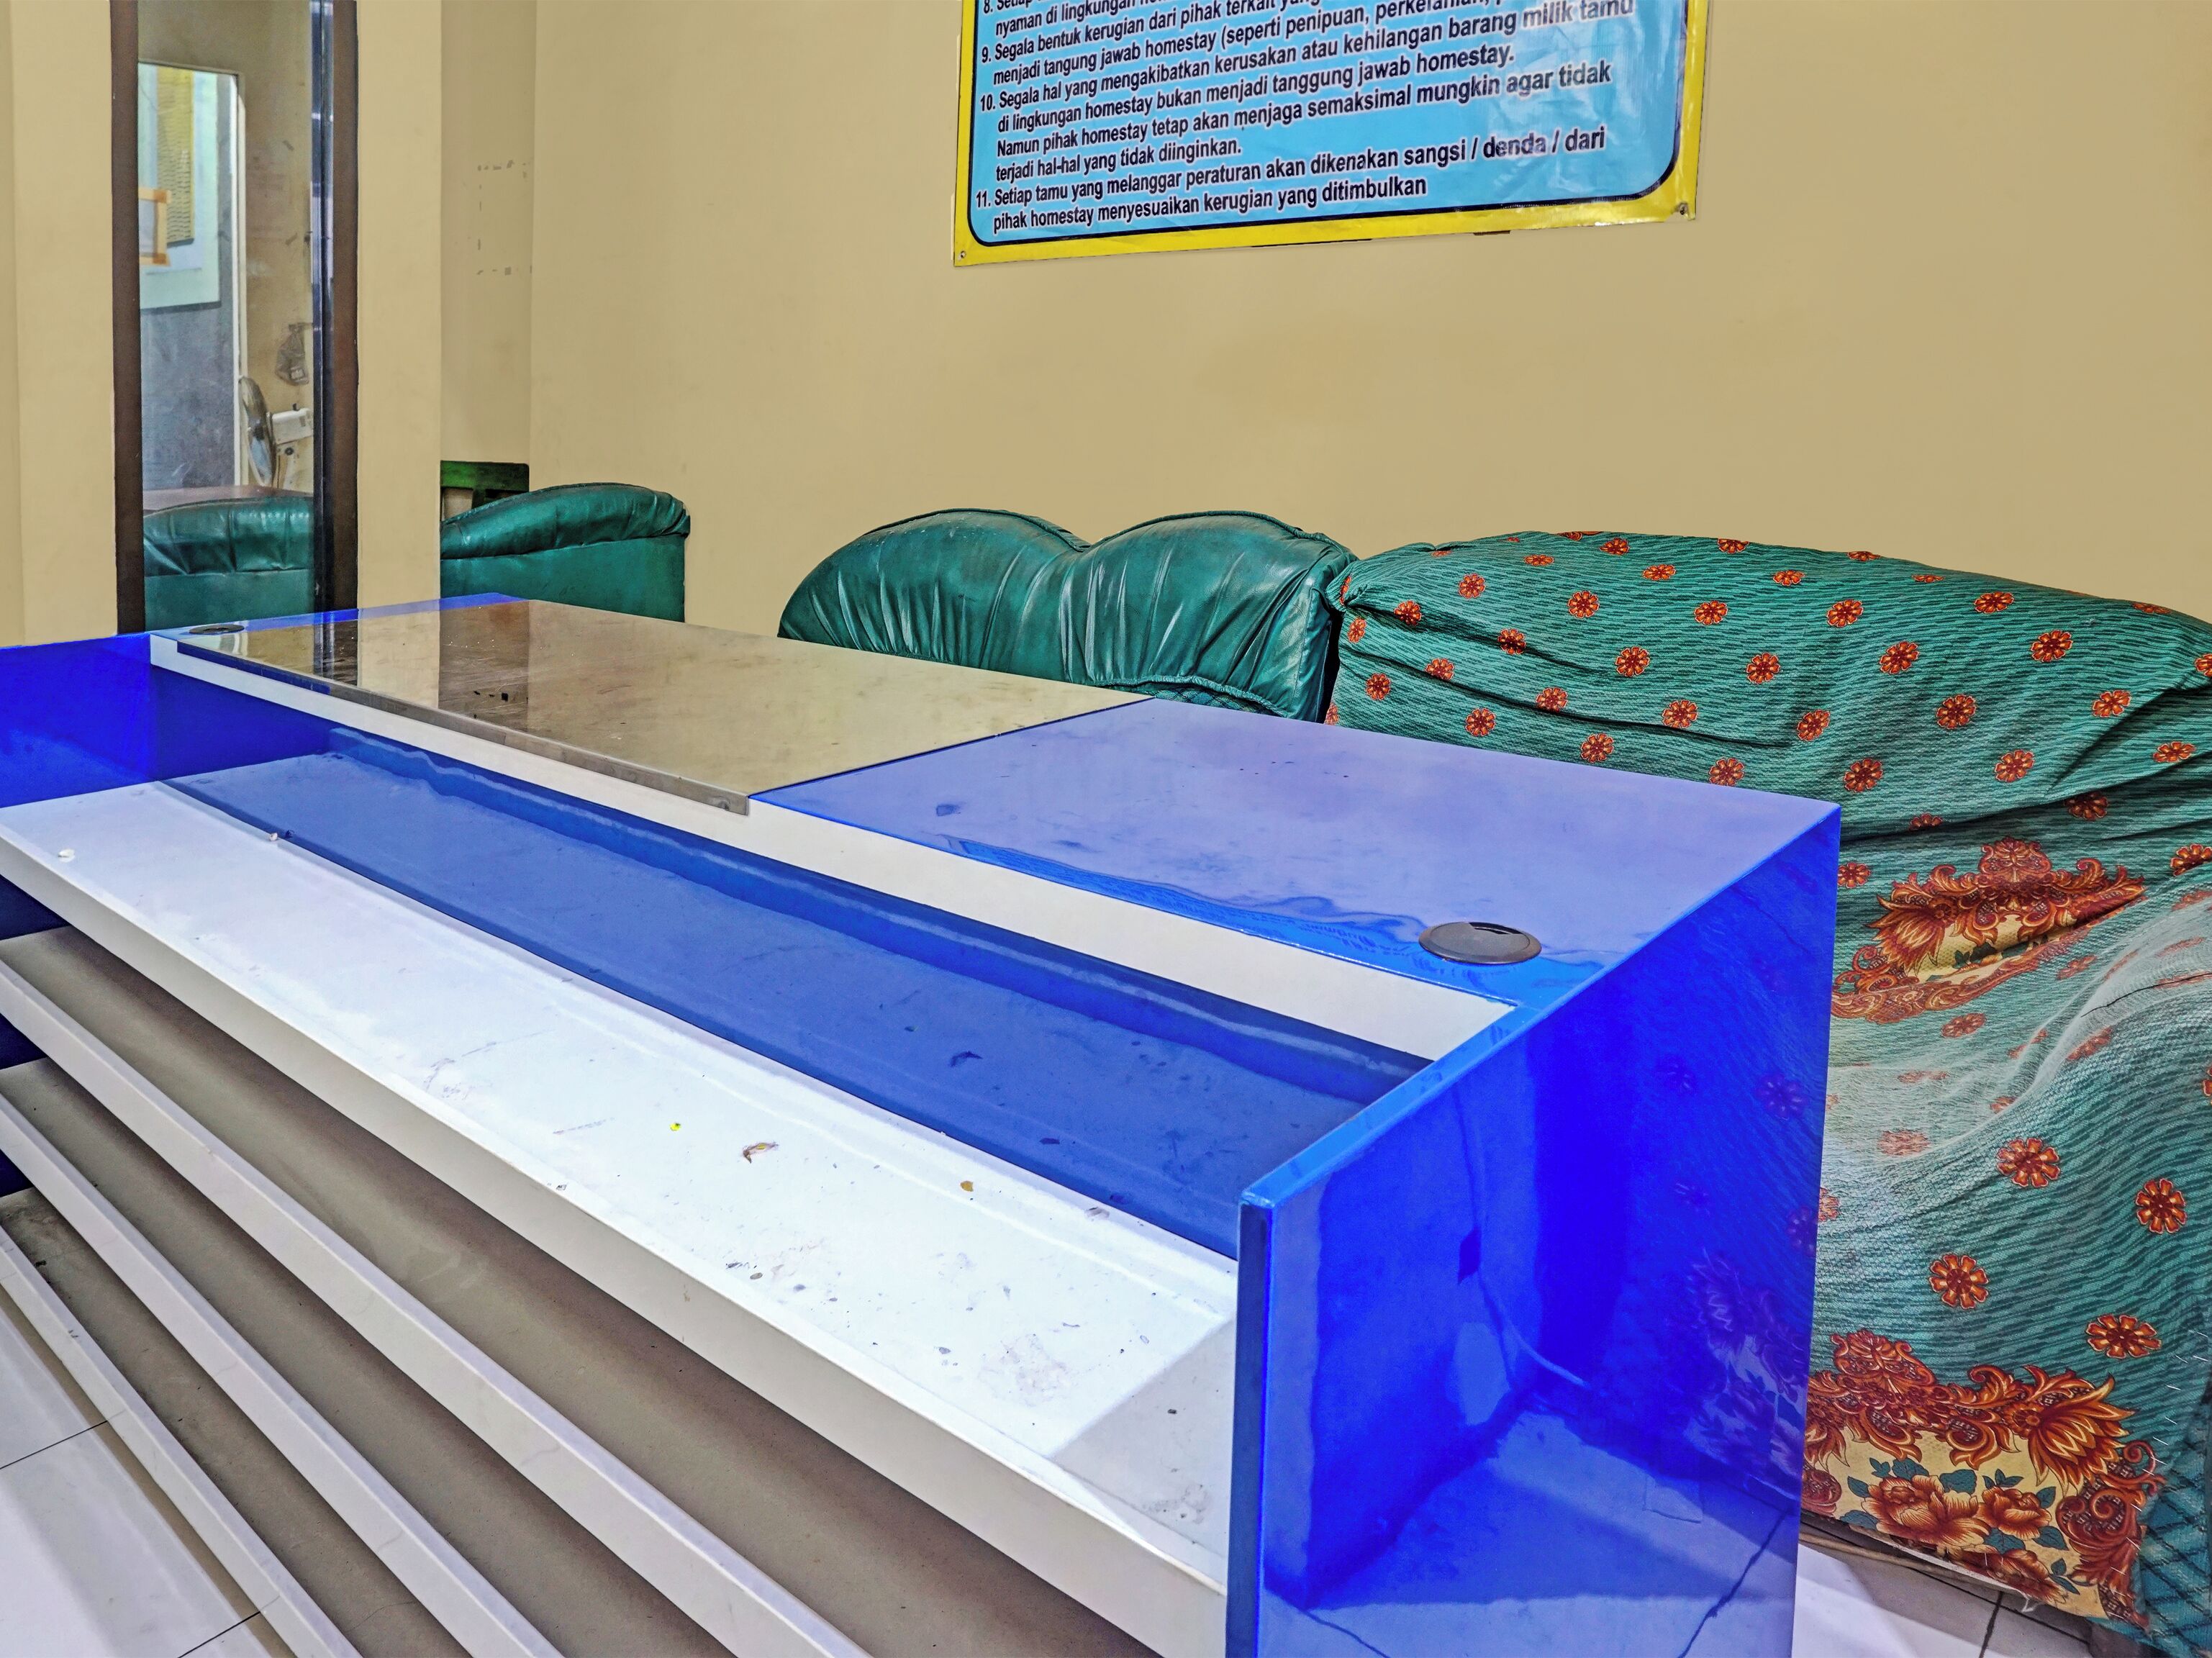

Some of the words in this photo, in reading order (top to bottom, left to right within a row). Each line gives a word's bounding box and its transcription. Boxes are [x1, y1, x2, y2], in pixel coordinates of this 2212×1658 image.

[982, 46, 992, 63] 9.
[994, 37, 1035, 62] Segala
[1037, 27, 1082, 52] bentuk
[1084, 17, 1144, 42] kerugian
[1148, 7, 1177, 30] dari
[1180, 0, 1221, 30] pihak
[983, 0, 993, 14] 8.
[993, 59, 1041, 86] menjadi
[1043, 53, 1097, 77] tangung
[1099, 42, 1141, 71] jawab
[1145, 32, 1217, 58] homestay
[1221, 16, 1281, 50] (seperti
[1285, 6, 1369, 40] penipuan,
[1375, 0, 1490, 25] perkela,
[995, 13, 1042, 39] nyaman
[1046, 5, 1058, 24] di
[1061, 0, 1136, 23] lingkungan
[980, 94, 996, 112] 10.
[999, 86, 1040, 110] Segala
[1043, 81, 1062, 101] hal
[1064, 79, 1098, 102] yang
[1100, 60, 1210, 91] mengakibatkan
[1215, 46, 1297, 73] kerusakan
[1301, 40, 1338, 60] atau
[1343, 24, 1443, 54] kehilangan
[1449, 13, 1517, 38] barang
[1522, 0, 1574, 28] milik
[1579, 0, 1633, 20] tamu
[997, 114, 1010, 133] di
[1012, 107, 1082, 133] lingkungan
[1085, 96, 1153, 119] homestay
[1156, 88, 1202, 109] bukan
[1206, 75, 1268, 104] menjadi
[1272, 68, 1353, 94] tanggung
[1357, 55, 1411, 87] jawab
[1416, 44, 1514, 73] homestay.
[997, 139, 1040, 158] Namun
[1043, 130, 1079, 155] pihak
[1082, 122, 1148, 146] homestay
[1151, 117, 1189, 137] tetap
[1192, 111, 1229, 132] akan
[1233, 102, 1302, 127] menjaga
[1307, 83, 1411, 117] semaksimal
[1416, 74, 1500, 104] mungkin
[1505, 71, 1554, 96] agar
[1559, 60, 1611, 87] tidak
[976, 190, 991, 208] 11.
[994, 186, 1033, 207] Setiap
[1035, 185, 1068, 201] tamu
[1071, 181, 1104, 203] yang
[1107, 173, 1182, 194] melanggar
[1186, 165, 1261, 191] peraturan
[1266, 158, 1305, 179] akan
[1310, 148, 1398, 175] dikenakan
[1404, 138, 1466, 168] sangsi
[1471, 137, 1479, 160] /
[1482, 132, 1546, 158] denda
[1551, 130, 1559, 153] /
[1564, 125, 1605, 152] dari
[996, 160, 1034, 184] terjadi
[1037, 154, 1081, 176] hal-hal
[1083, 154, 1117, 176] yang
[1120, 145, 1155, 167] tidak
[1159, 137, 1241, 164] diinginkan.
[994, 211, 1028, 235] pihak
[1030, 206, 1094, 227] homestay
[1097, 196, 1200, 223] menyesuaikan
[1204, 189, 1273, 214] kerugian
[1277, 188, 1318, 211] yang
[1322, 176, 1426, 202] ditimbulkan
